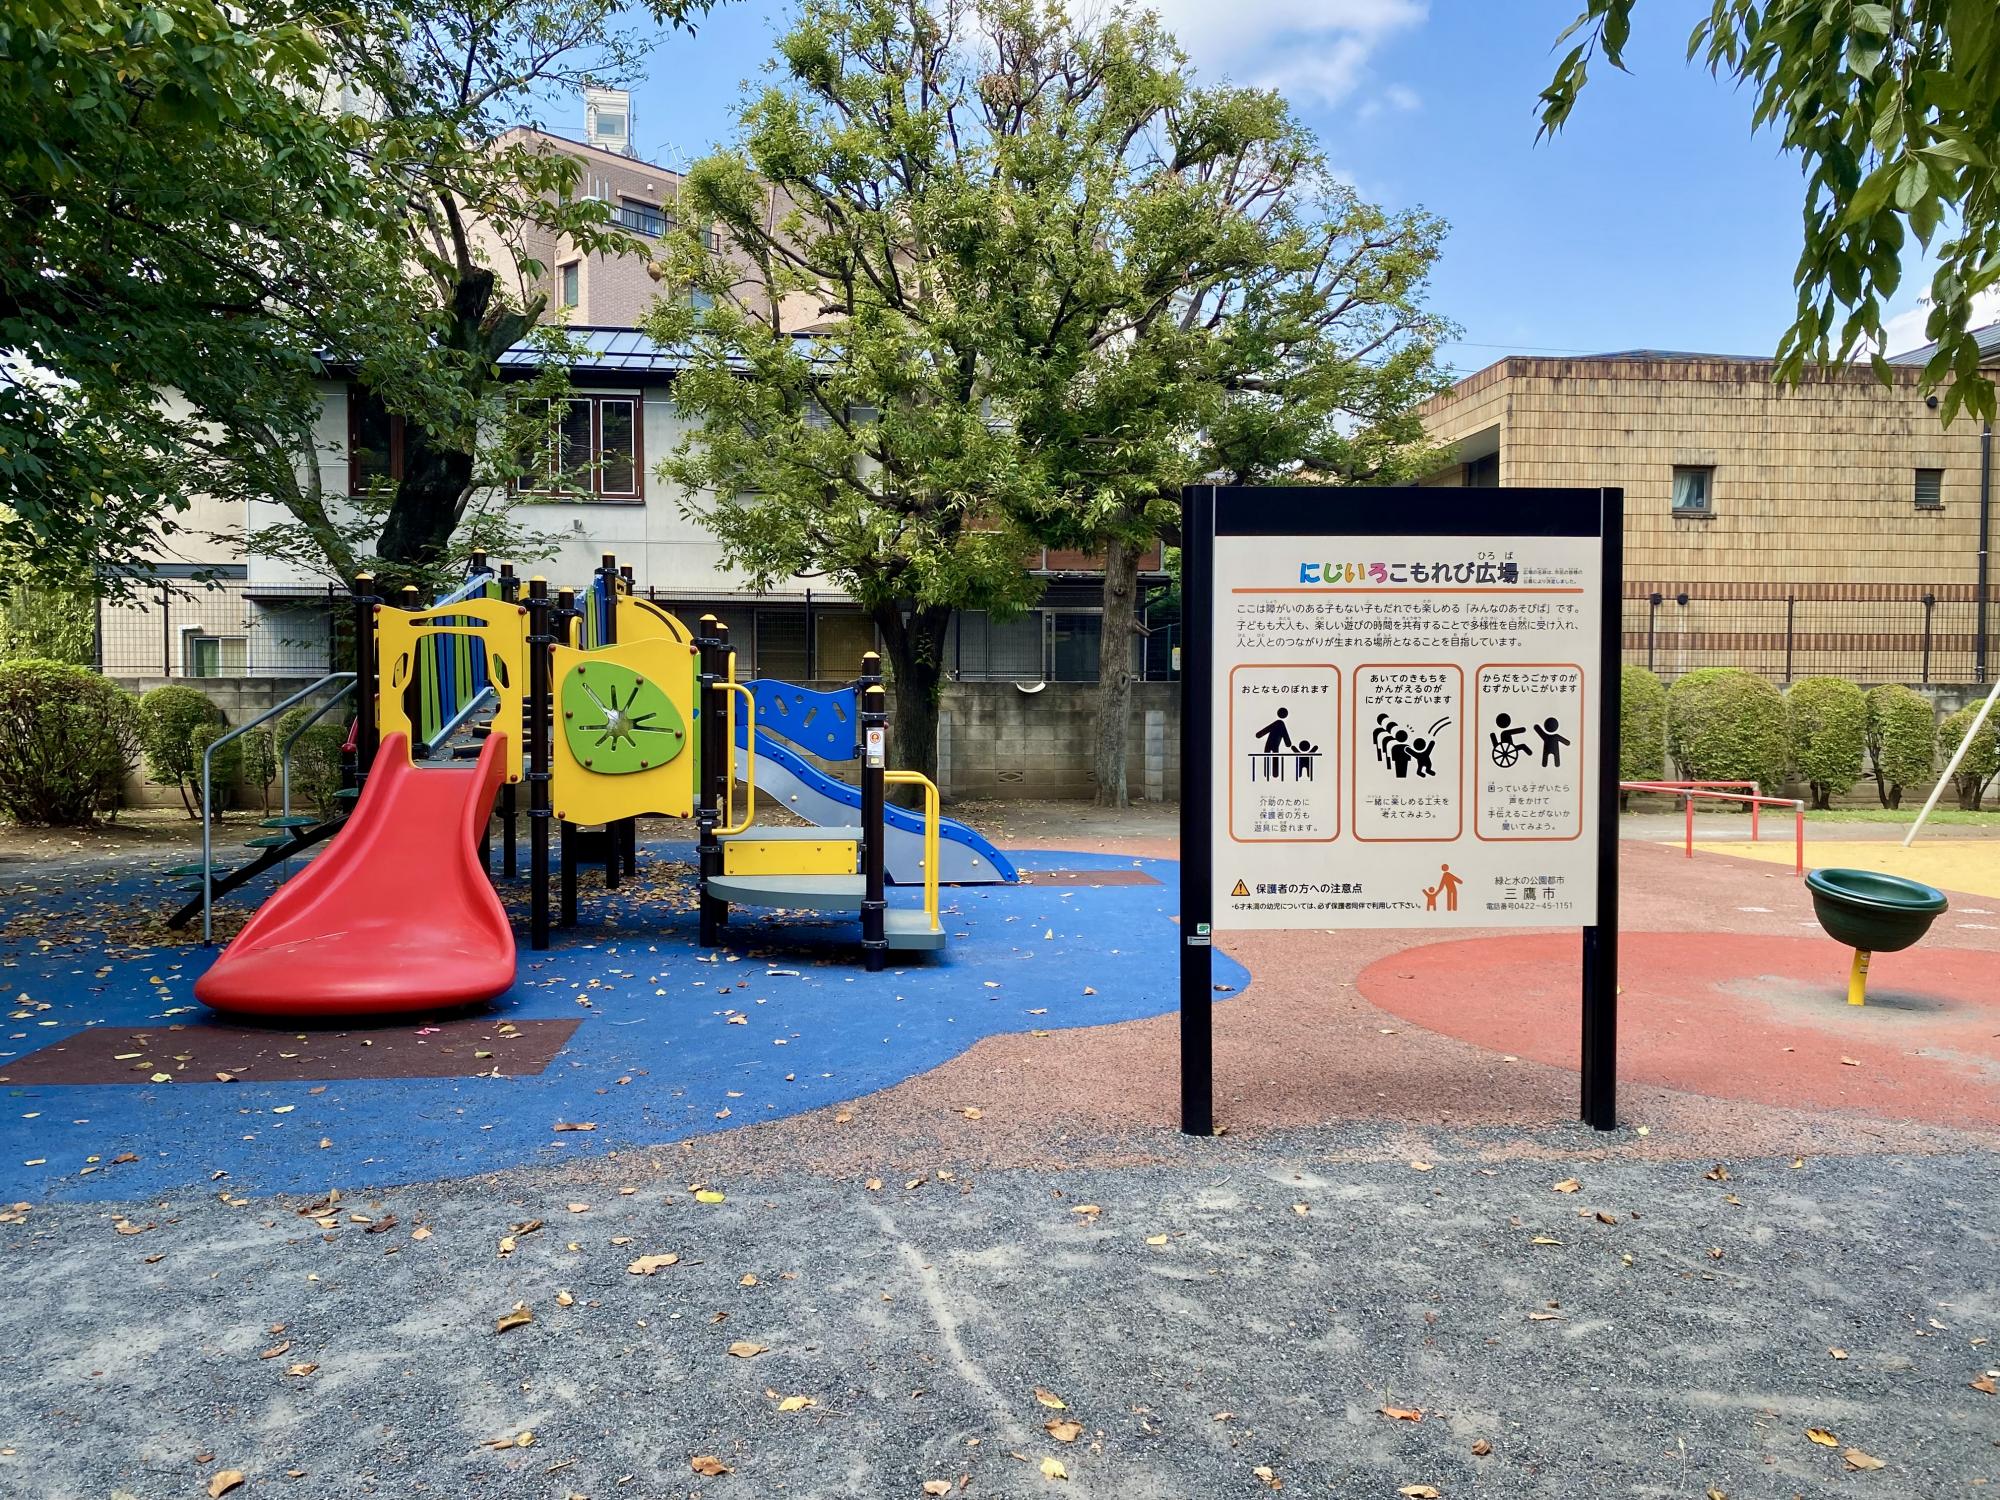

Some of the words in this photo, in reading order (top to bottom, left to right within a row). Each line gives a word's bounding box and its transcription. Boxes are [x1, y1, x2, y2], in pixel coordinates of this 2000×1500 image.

[1477, 551, 1496, 560] ひろ
[1299, 562, 1519, 584] にじいろこもれび広場
[1236, 604, 1580, 614] ここは障がいのある子もない子もだれでも楽しめる「みんなのあそびば」です。
[1236, 620, 1580, 631] 子どもも大人も、楽しい遊びの時間を共有することで多様性を自然に受け入れ、
[1236, 637, 1523, 648] 人と人とのつながりが生まれる場所となることを目指しています。
[1370, 674, 1448, 683] あいてのきもちを
[1482, 673, 1578, 683] からだをうごかすのが
[1241, 685, 1329, 694] おとなものぼれます
[1374, 685, 1443, 694] かんがえるのが
[1482, 684, 1578, 694] むずかしいこがいます
[1365, 695, 1452, 705] にがてなこがいます
[1487, 784, 1570, 793] 困っている子がいたら
[1259, 798, 1310, 806] 介助のために
[1365, 798, 1450, 806] 一緒に楽しめる工夫を
[1509, 797, 1551, 805] 声をかけて
[1381, 810, 1437, 819] 考えてみよう。
[1488, 810, 1571, 819] 手伝えることがないか
[1494, 876, 1565, 885] 緑と水の公園都市
[1255, 883, 1363, 894] 保護者の方への注意点
